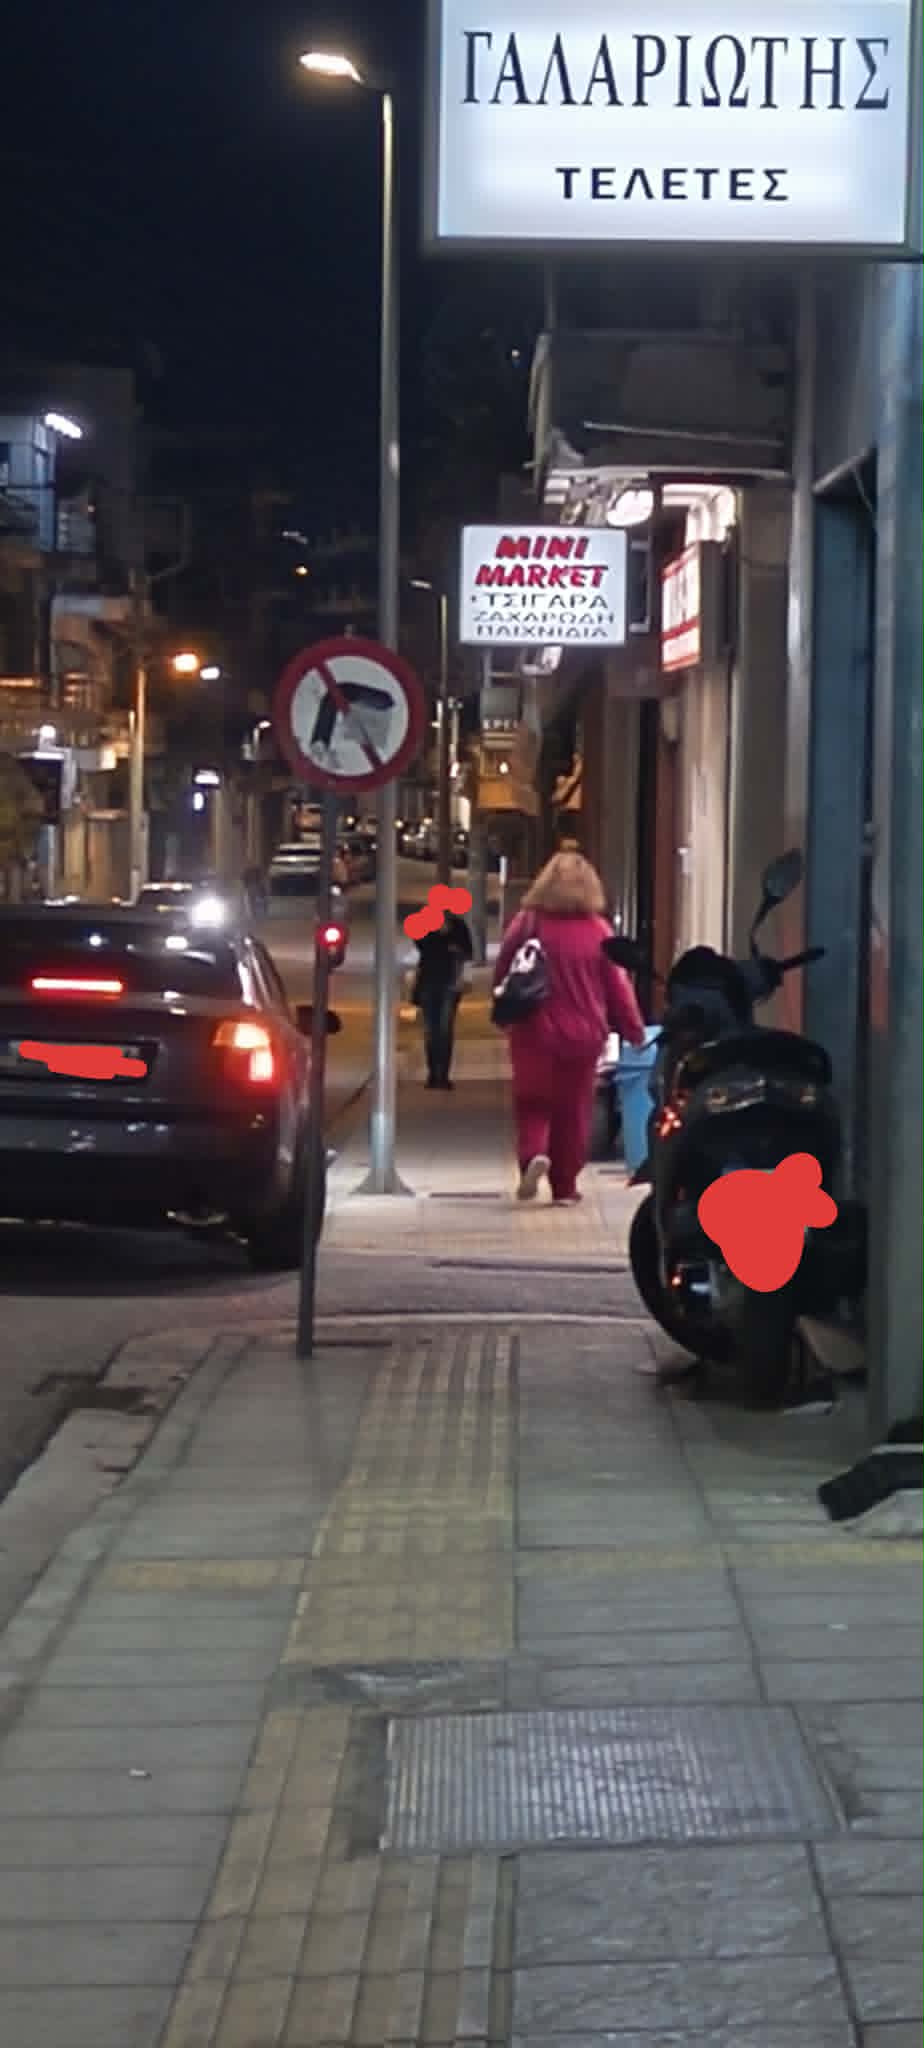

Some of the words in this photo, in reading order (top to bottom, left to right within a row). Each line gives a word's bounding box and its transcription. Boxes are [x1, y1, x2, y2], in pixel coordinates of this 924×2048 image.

[461, 31, 890, 110] ΓΑΛΑΡΙΩΤΗΣ
[556, 167, 790, 202] ΤΕΛΕΤΕΣ
[495, 535, 590, 560] MINI
[475, 564, 609, 589] MARKET
[483, 593, 609, 608] ΤΣΙΓΑΡΑ
[476, 625, 609, 638] ΠΑΙΧΝΙΔΙΑ
